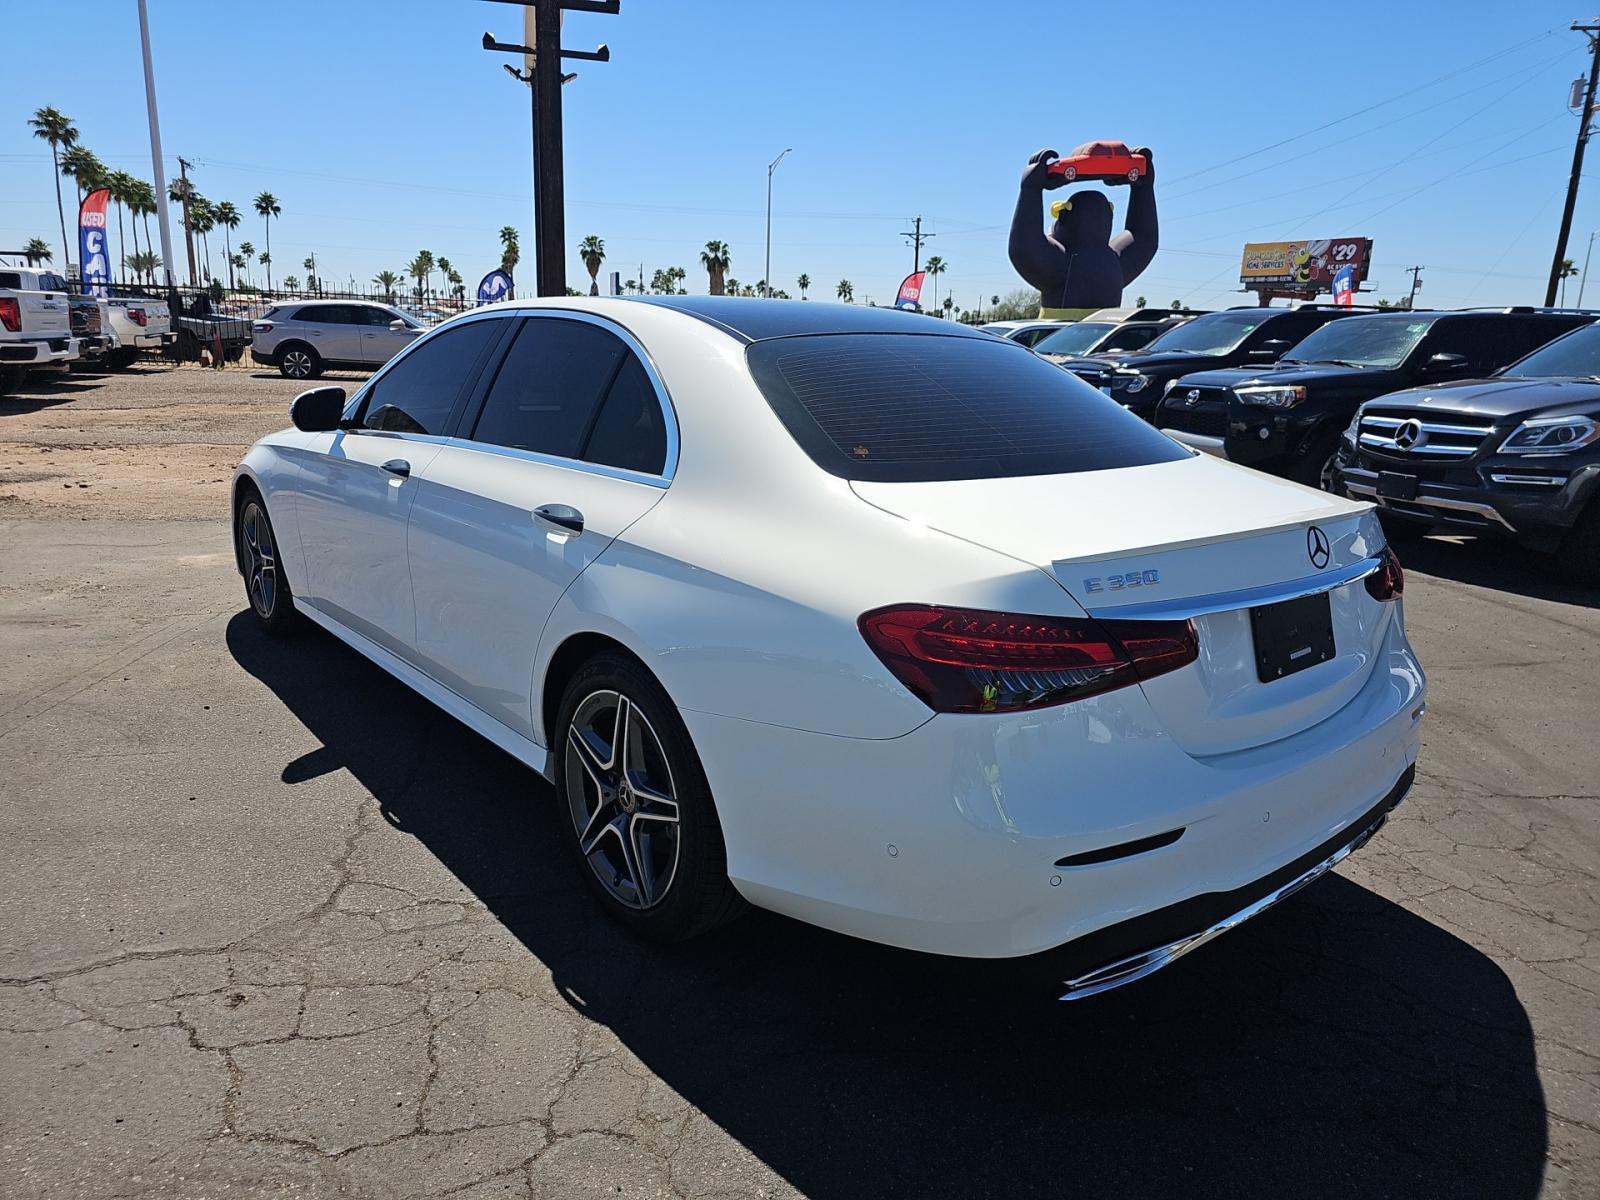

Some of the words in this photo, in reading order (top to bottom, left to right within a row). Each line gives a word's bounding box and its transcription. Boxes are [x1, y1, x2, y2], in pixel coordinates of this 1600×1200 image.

[81, 212, 105, 227] USED
[1332, 244, 1357, 261] $29
[1335, 277, 1350, 292] WE
[1083, 577, 1103, 594] E
[1107, 569, 1160, 592] 350
